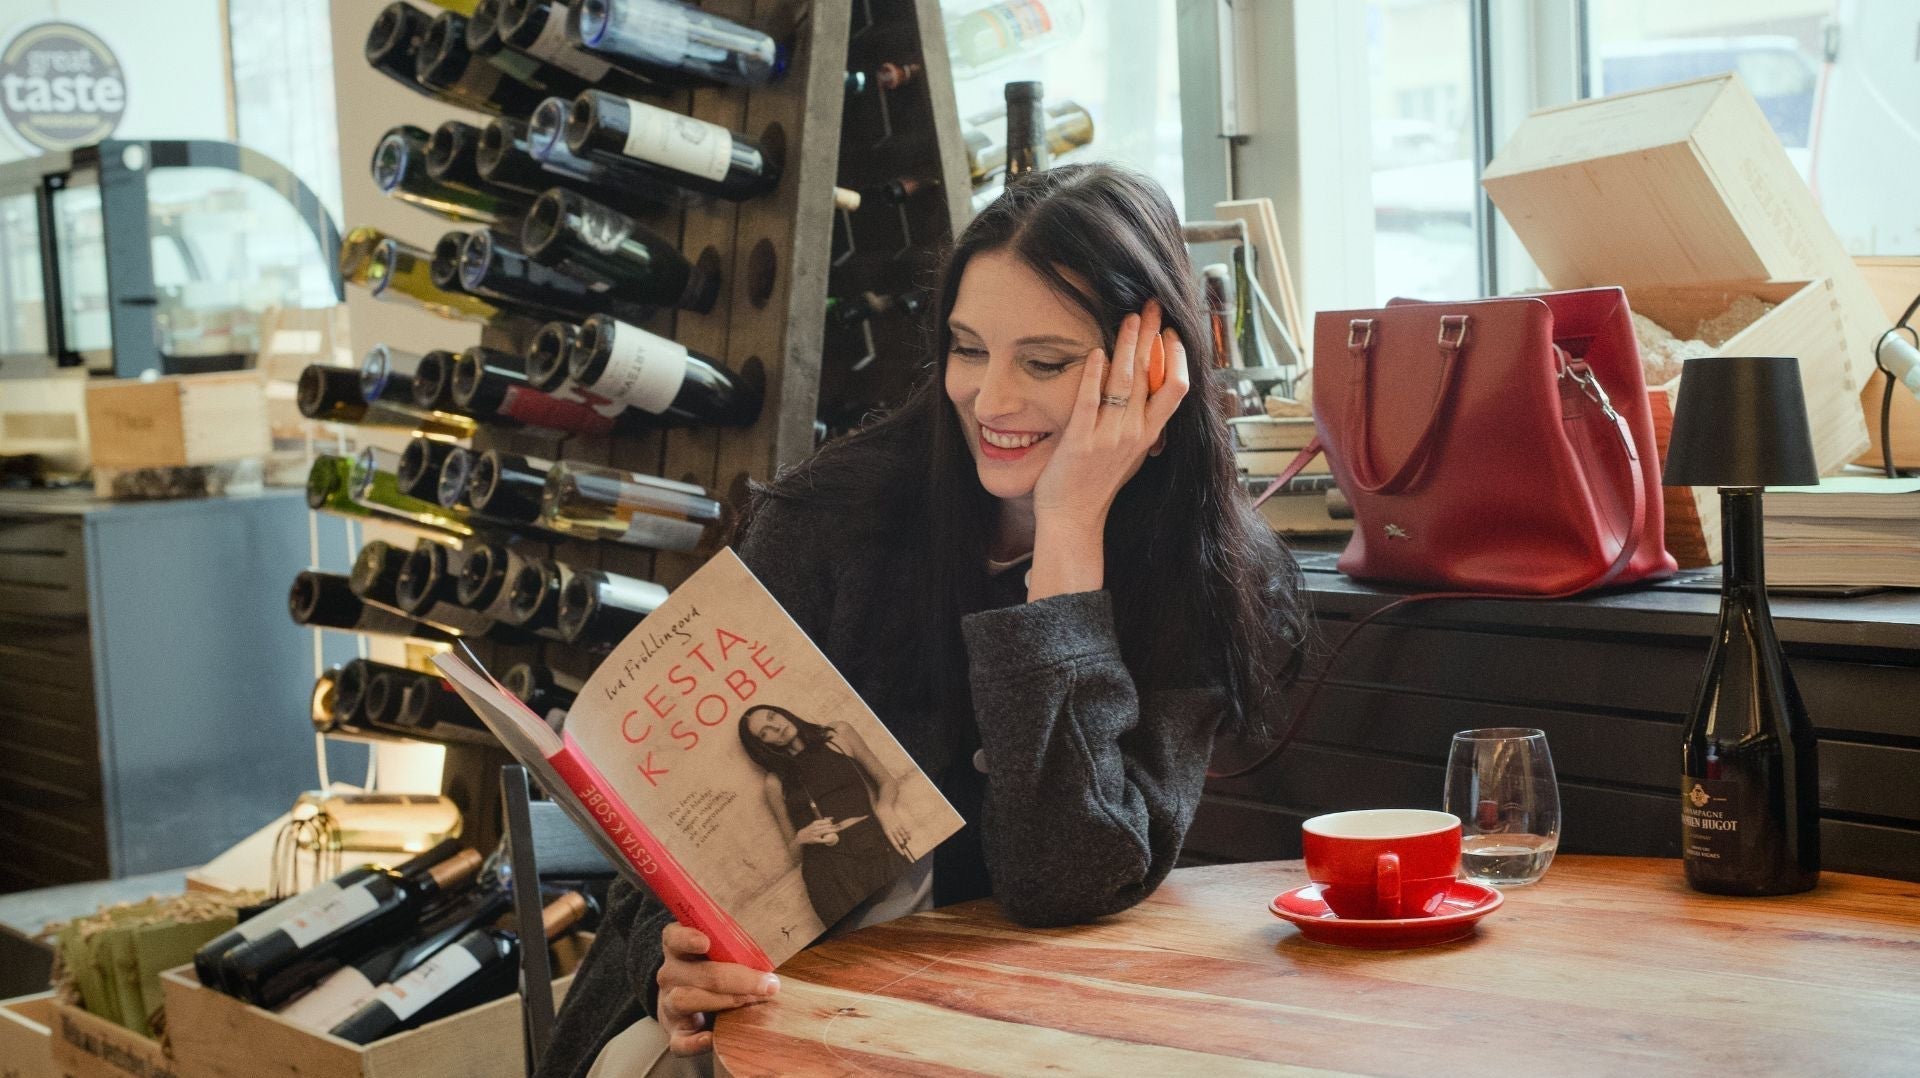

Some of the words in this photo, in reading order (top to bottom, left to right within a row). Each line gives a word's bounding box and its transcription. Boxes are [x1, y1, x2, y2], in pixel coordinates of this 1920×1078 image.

[27, 49, 93, 77] great
[4, 73, 124, 112] taste
[605, 680, 626, 700] Iva
[621, 628, 749, 744] CESTA
[637, 751, 670, 787] K
[670, 640, 786, 751] SOBĚ
[611, 821, 627, 835] K
[1702, 818, 1738, 831] HUGOT
[621, 833, 659, 875] CESTA
